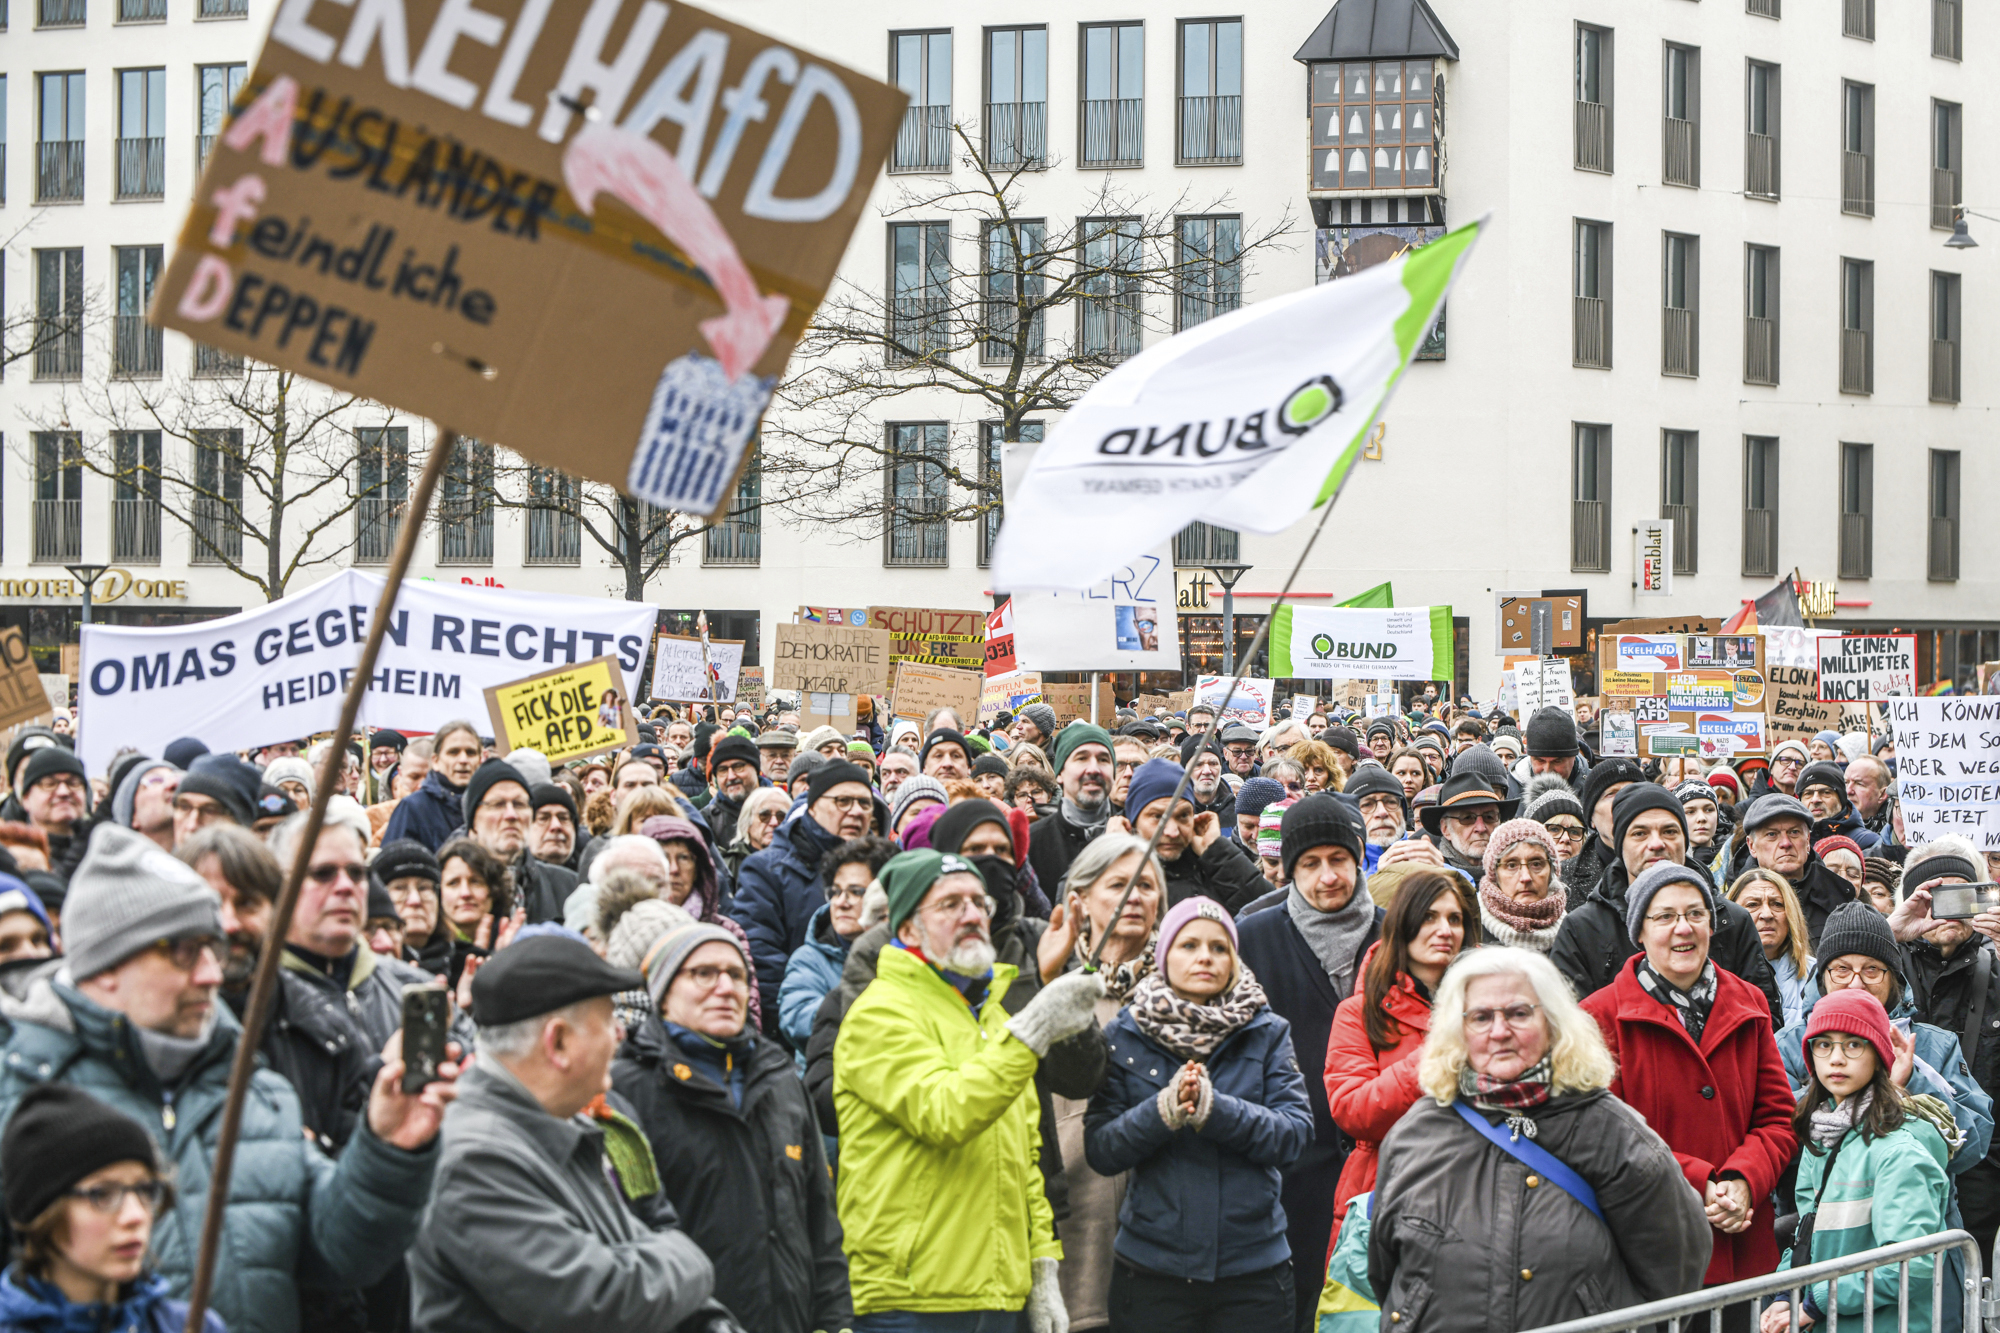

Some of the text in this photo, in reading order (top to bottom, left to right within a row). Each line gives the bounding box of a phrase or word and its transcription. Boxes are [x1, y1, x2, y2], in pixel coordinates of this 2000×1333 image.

[270, 0, 862, 222] ELHAfD
[211, 173, 498, 327] feindliche
[177, 253, 377, 379] DEPPEN
[1645, 525, 1662, 591] extrablatt
[875, 609, 982, 635] SCHÜTZT
[778, 625, 874, 645] WER IN DER
[929, 634, 969, 642] AFD-VERBOT.DE
[90, 640, 237, 696] OMAS
[431, 613, 644, 672] RECHTS
[777, 641, 880, 664] DEMOKRATIE
[897, 640, 959, 657] UNSERE
[1337, 642, 1398, 659] BUND
[1622, 644, 1675, 655] EKELHAfD
[1842, 638, 1899, 656] KEINEN
[775, 661, 822, 676] SCHLÄFT
[866, 667, 876, 680] IN
[1821, 654, 1910, 675] MILLIMETER
[796, 676, 848, 692] DIKTATUR
[1770, 667, 1809, 686] ELON
[263, 667, 461, 710] HEIDEHEIM
[983, 681, 1021, 694] ARTOFFELN
[1670, 685, 1724, 696] MILLIMETER
[1779, 687, 1800, 700] kommt
[1823, 679, 1869, 700] NACH
[513, 681, 597, 730] FICK DIE
[1042, 694, 1091, 704] MENSCHEN
[1636, 698, 1668, 709] FCK
[1670, 696, 1730, 707] NACH RECHTS
[1636, 709, 1669, 721] AFD
[1775, 699, 1828, 720] Berghain
[1893, 701, 1919, 722] ICH
[546, 715, 593, 747] AFD
[1701, 722, 1756, 734] EKELHAfD
[1897, 730, 2000, 749] AUF DEM SO
[1900, 756, 1947, 776] ABER
[1907, 809, 1988, 826] ICH JETZT
